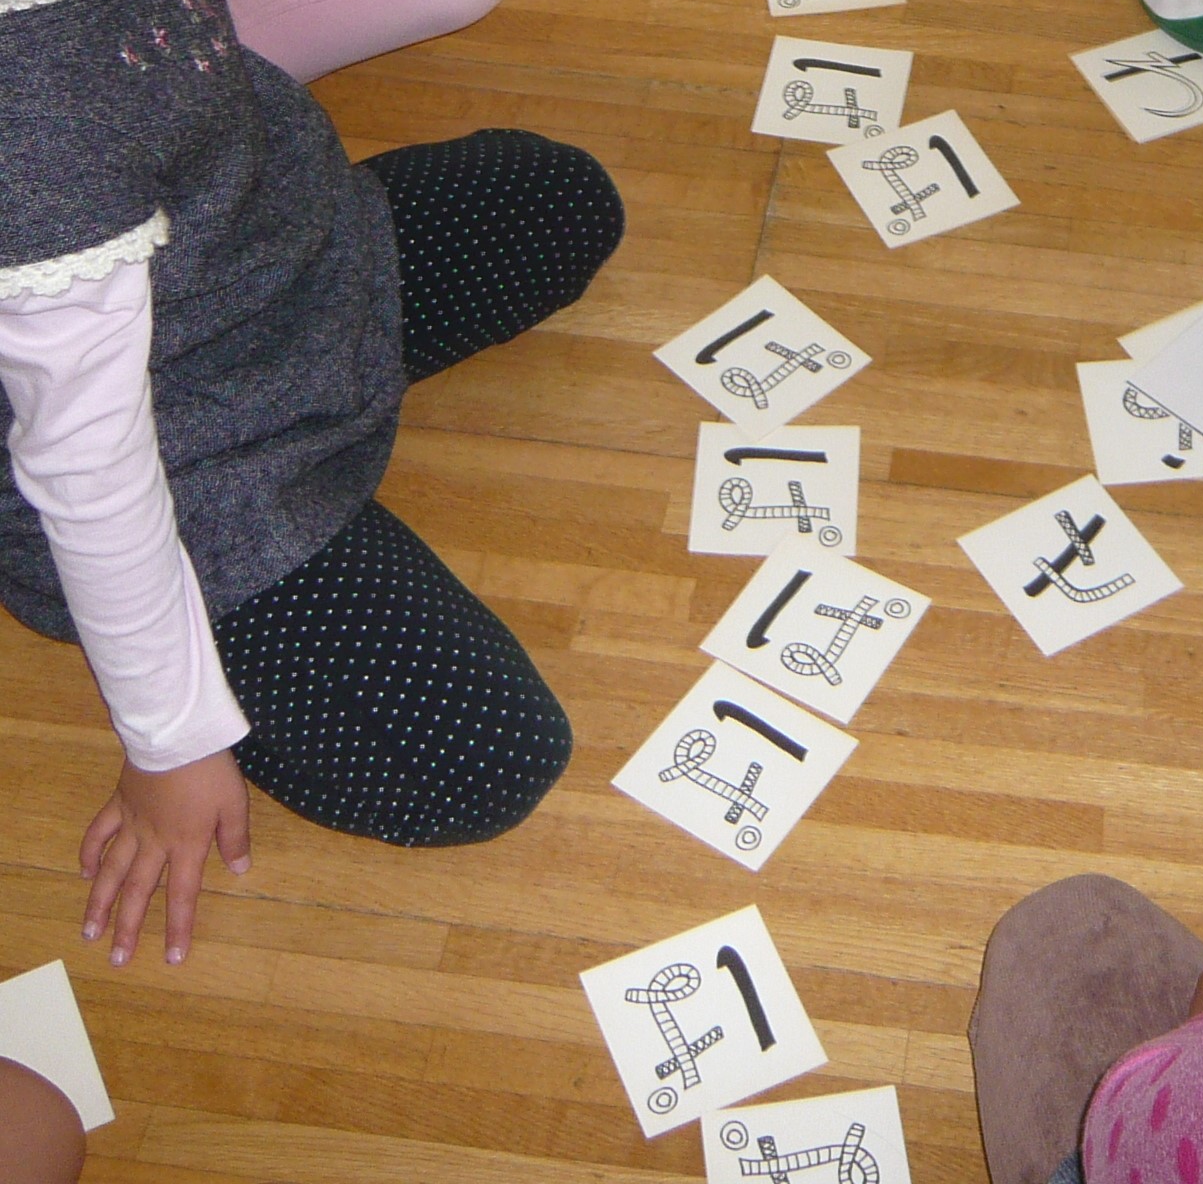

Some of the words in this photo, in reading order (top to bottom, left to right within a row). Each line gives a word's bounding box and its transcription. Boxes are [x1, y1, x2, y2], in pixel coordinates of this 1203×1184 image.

[784, 59, 882, 138] ぱ
[863, 135, 979, 236] ぱ
[696, 310, 852, 409] ぱ
[720, 448, 842, 547] ぱ
[1024, 510, 1134, 603] せ
[746, 570, 911, 685] ぱ
[658, 699, 807, 851] ぱ
[625, 946, 776, 1114] ぱ
